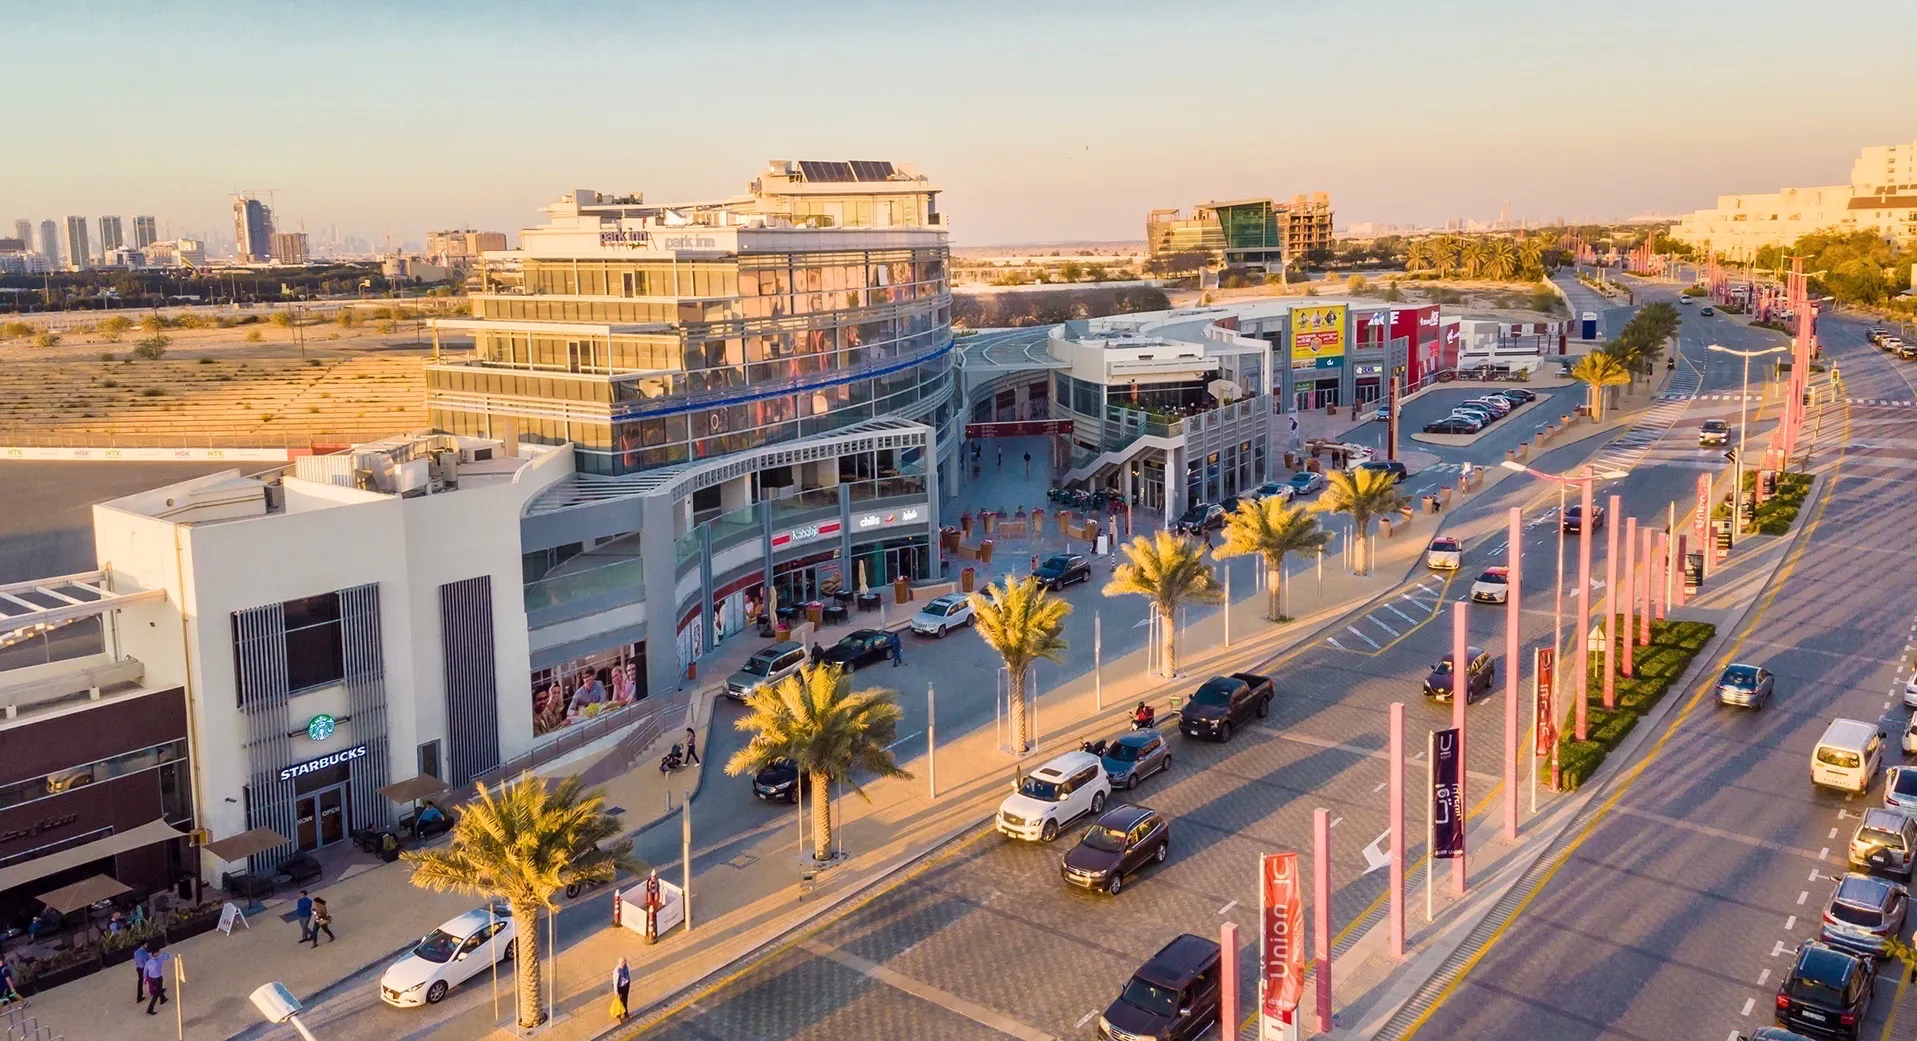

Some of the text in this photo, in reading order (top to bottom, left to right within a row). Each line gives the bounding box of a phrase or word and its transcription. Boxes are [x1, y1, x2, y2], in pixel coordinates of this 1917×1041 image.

[600, 227, 648, 243] park inn
[280, 746, 366, 780] STARBUCKS
[322, 806, 340, 817] OPEN
[1270, 903, 1289, 979] Union
